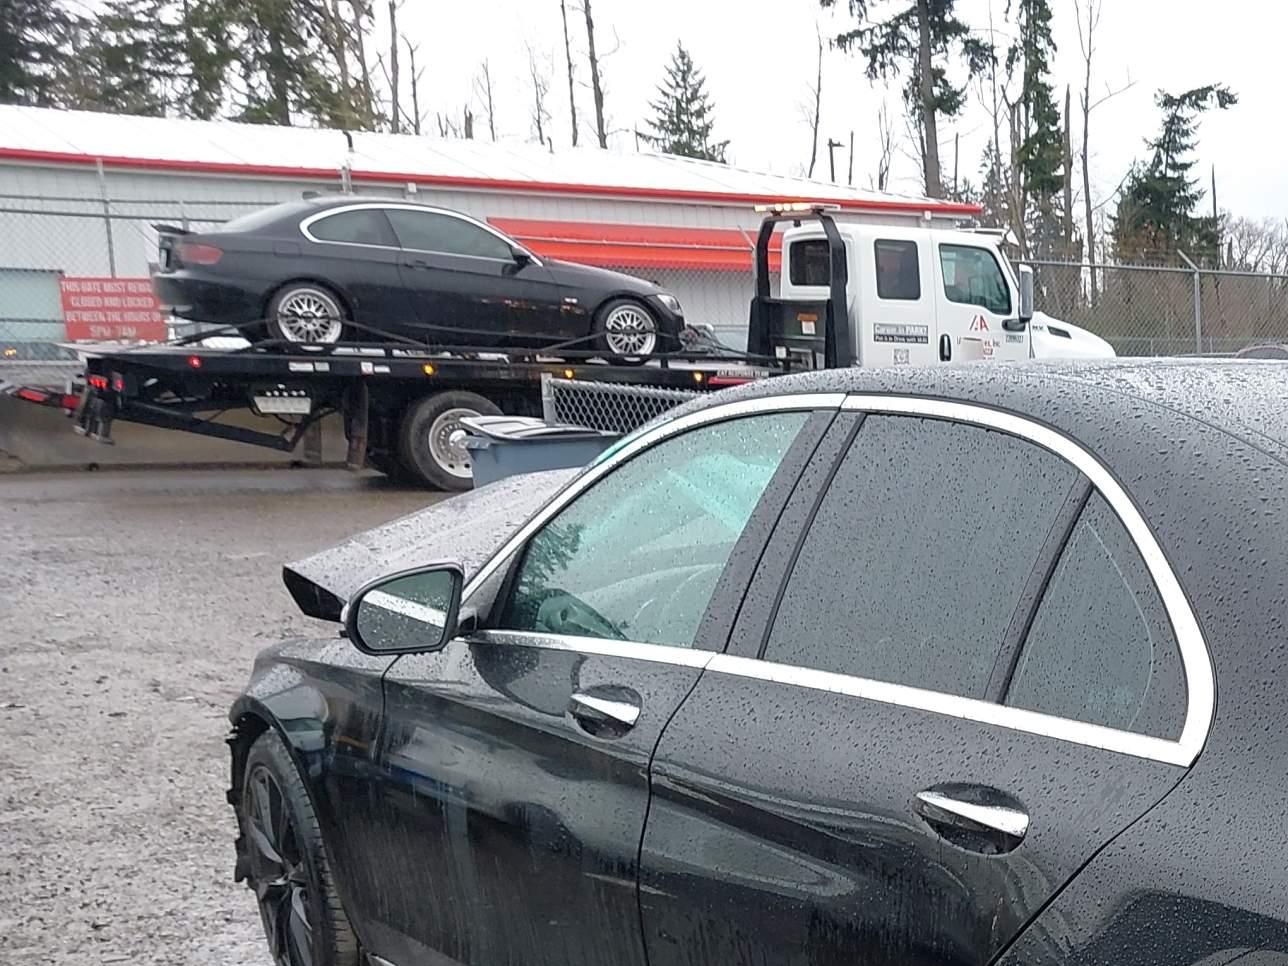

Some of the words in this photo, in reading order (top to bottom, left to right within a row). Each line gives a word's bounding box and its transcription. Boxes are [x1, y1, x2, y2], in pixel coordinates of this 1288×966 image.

[61, 281, 81, 292] THIS
[71, 295, 102, 308] CLOSED
[122, 296, 154, 308] LOCKED
[65, 311, 106, 322] BETWEEN
